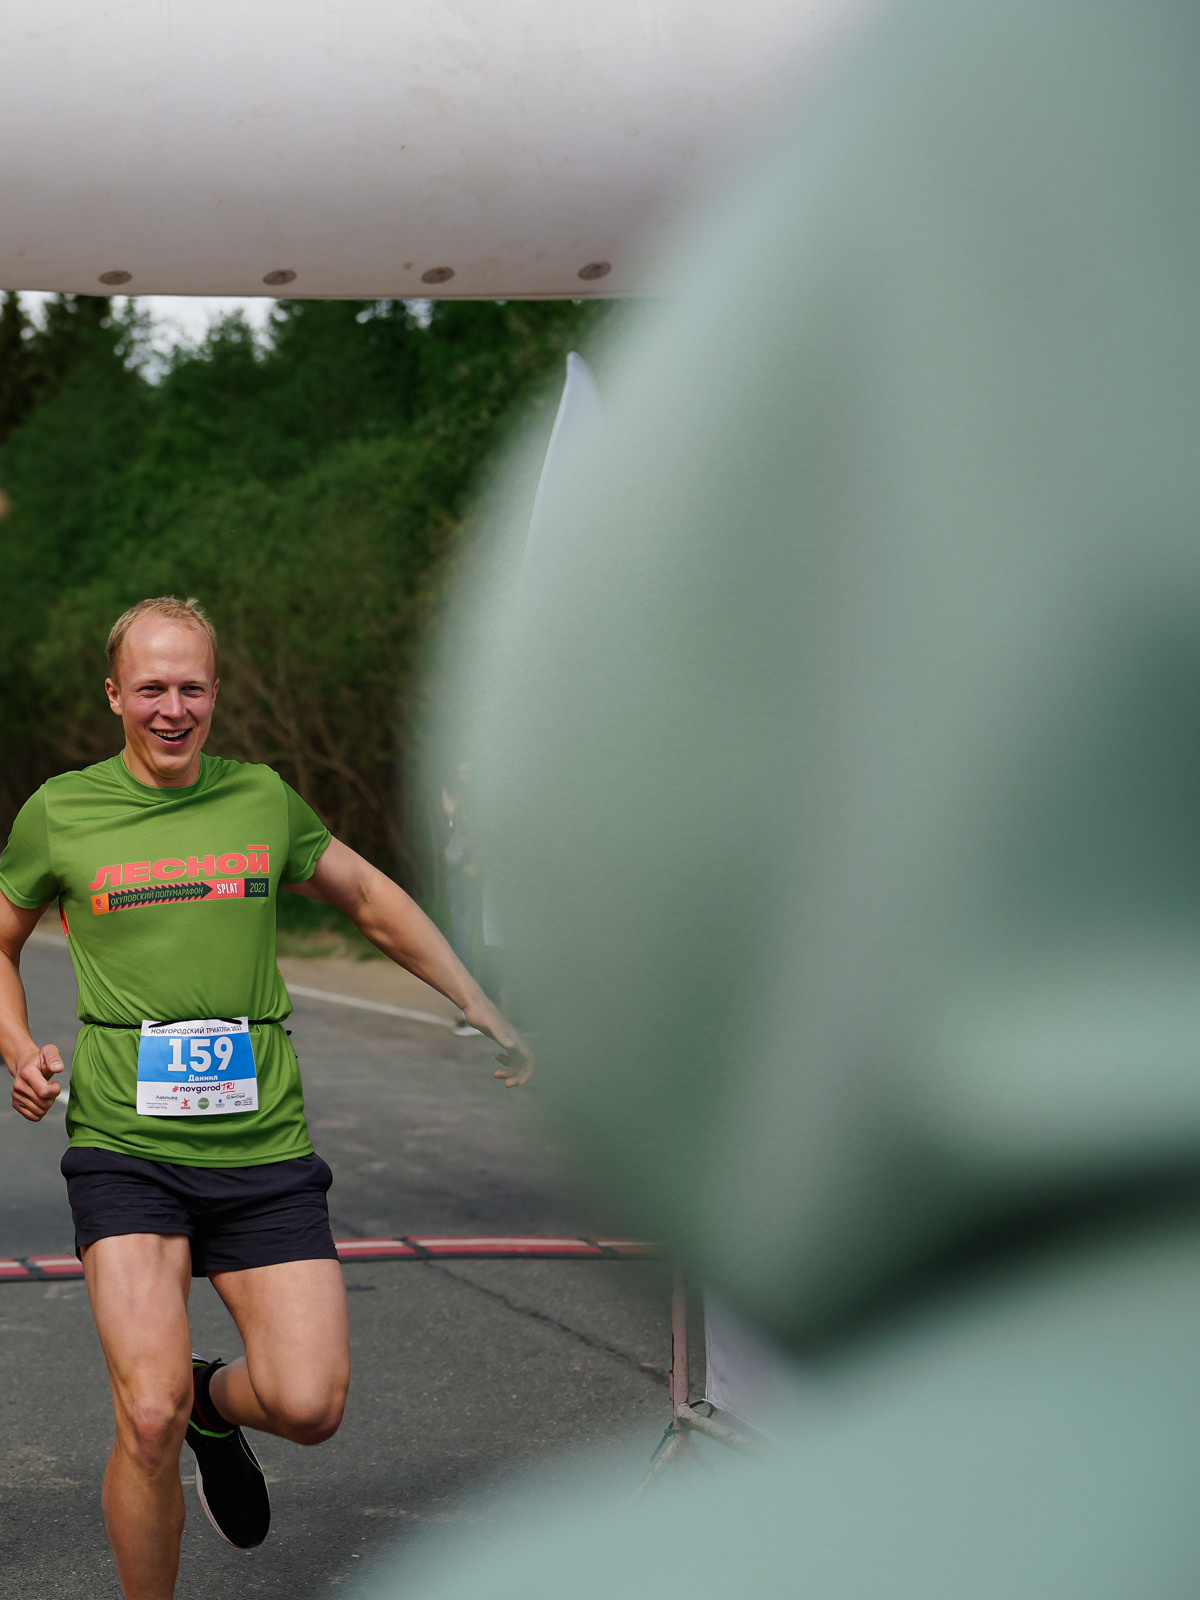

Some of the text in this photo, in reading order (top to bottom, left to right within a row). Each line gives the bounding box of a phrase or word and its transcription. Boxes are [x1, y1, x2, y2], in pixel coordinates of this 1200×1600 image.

[89, 845, 269, 890] ЛЕСНОЙ
[110, 882, 266, 906] ОКУЛОВСКИЙ ПОЛУМАРАФОН SPLAT 2023
[151, 1027, 205, 1035] НОВГОРОДСКИЙ
[167, 1036, 234, 1072] 159
[188, 1074, 218, 1082] Даниил
